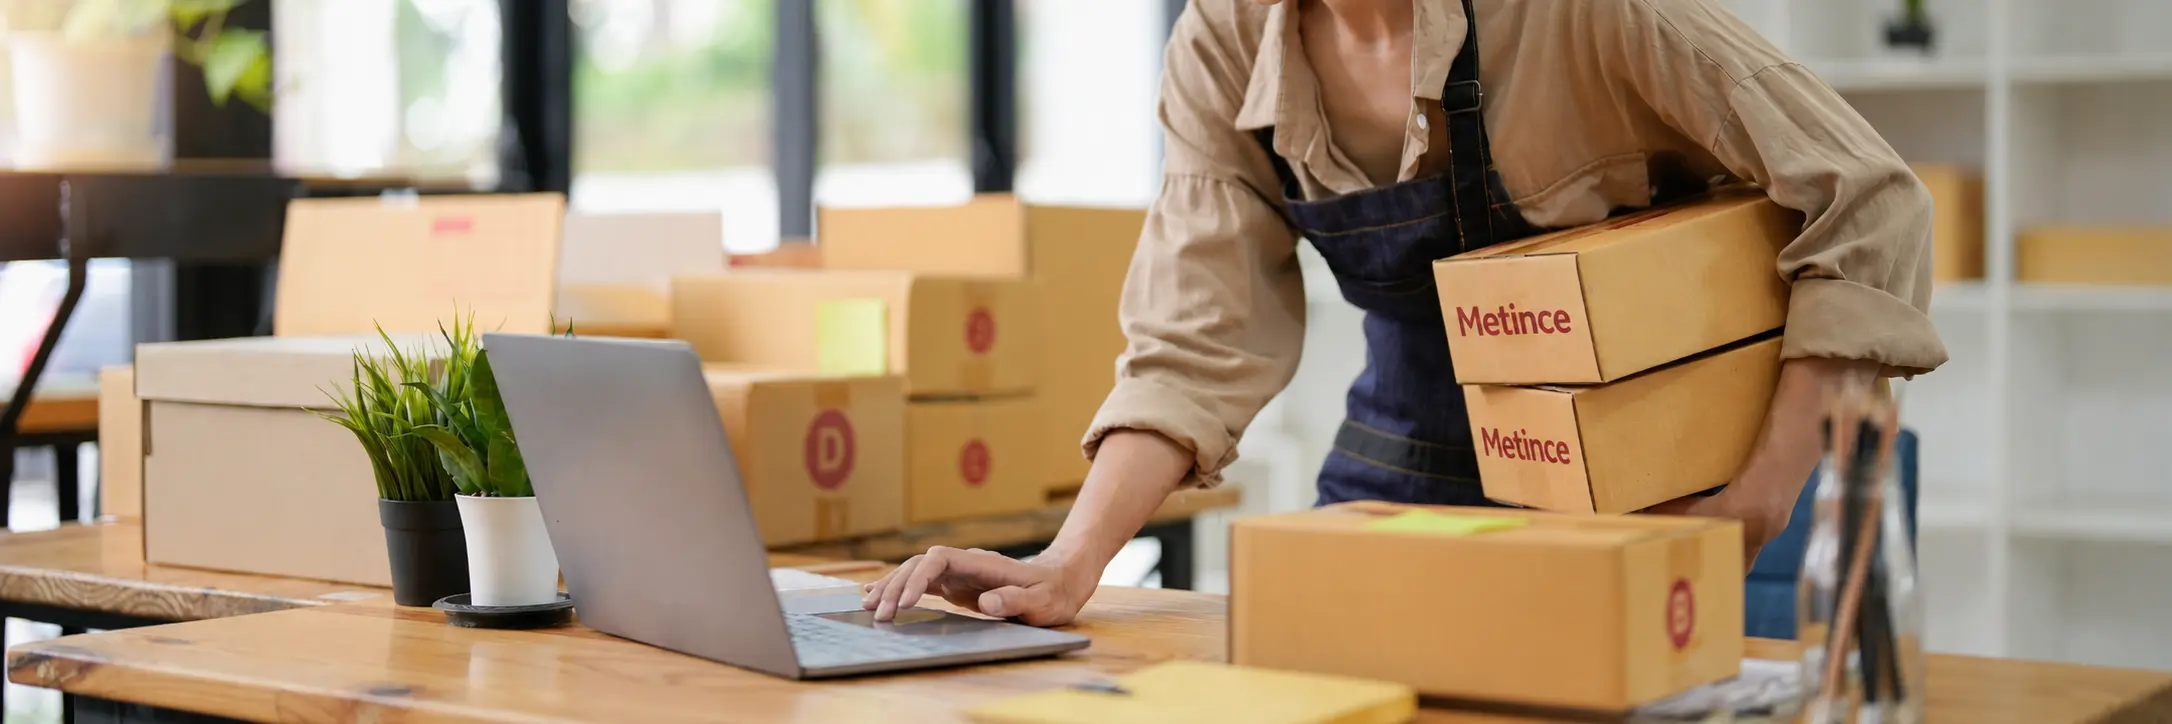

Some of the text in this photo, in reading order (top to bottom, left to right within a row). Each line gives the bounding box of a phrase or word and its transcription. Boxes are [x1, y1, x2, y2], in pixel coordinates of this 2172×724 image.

[1456, 303, 1571, 336] Metince
[818, 426, 846, 470] D
[1481, 427, 1571, 465] Metince
